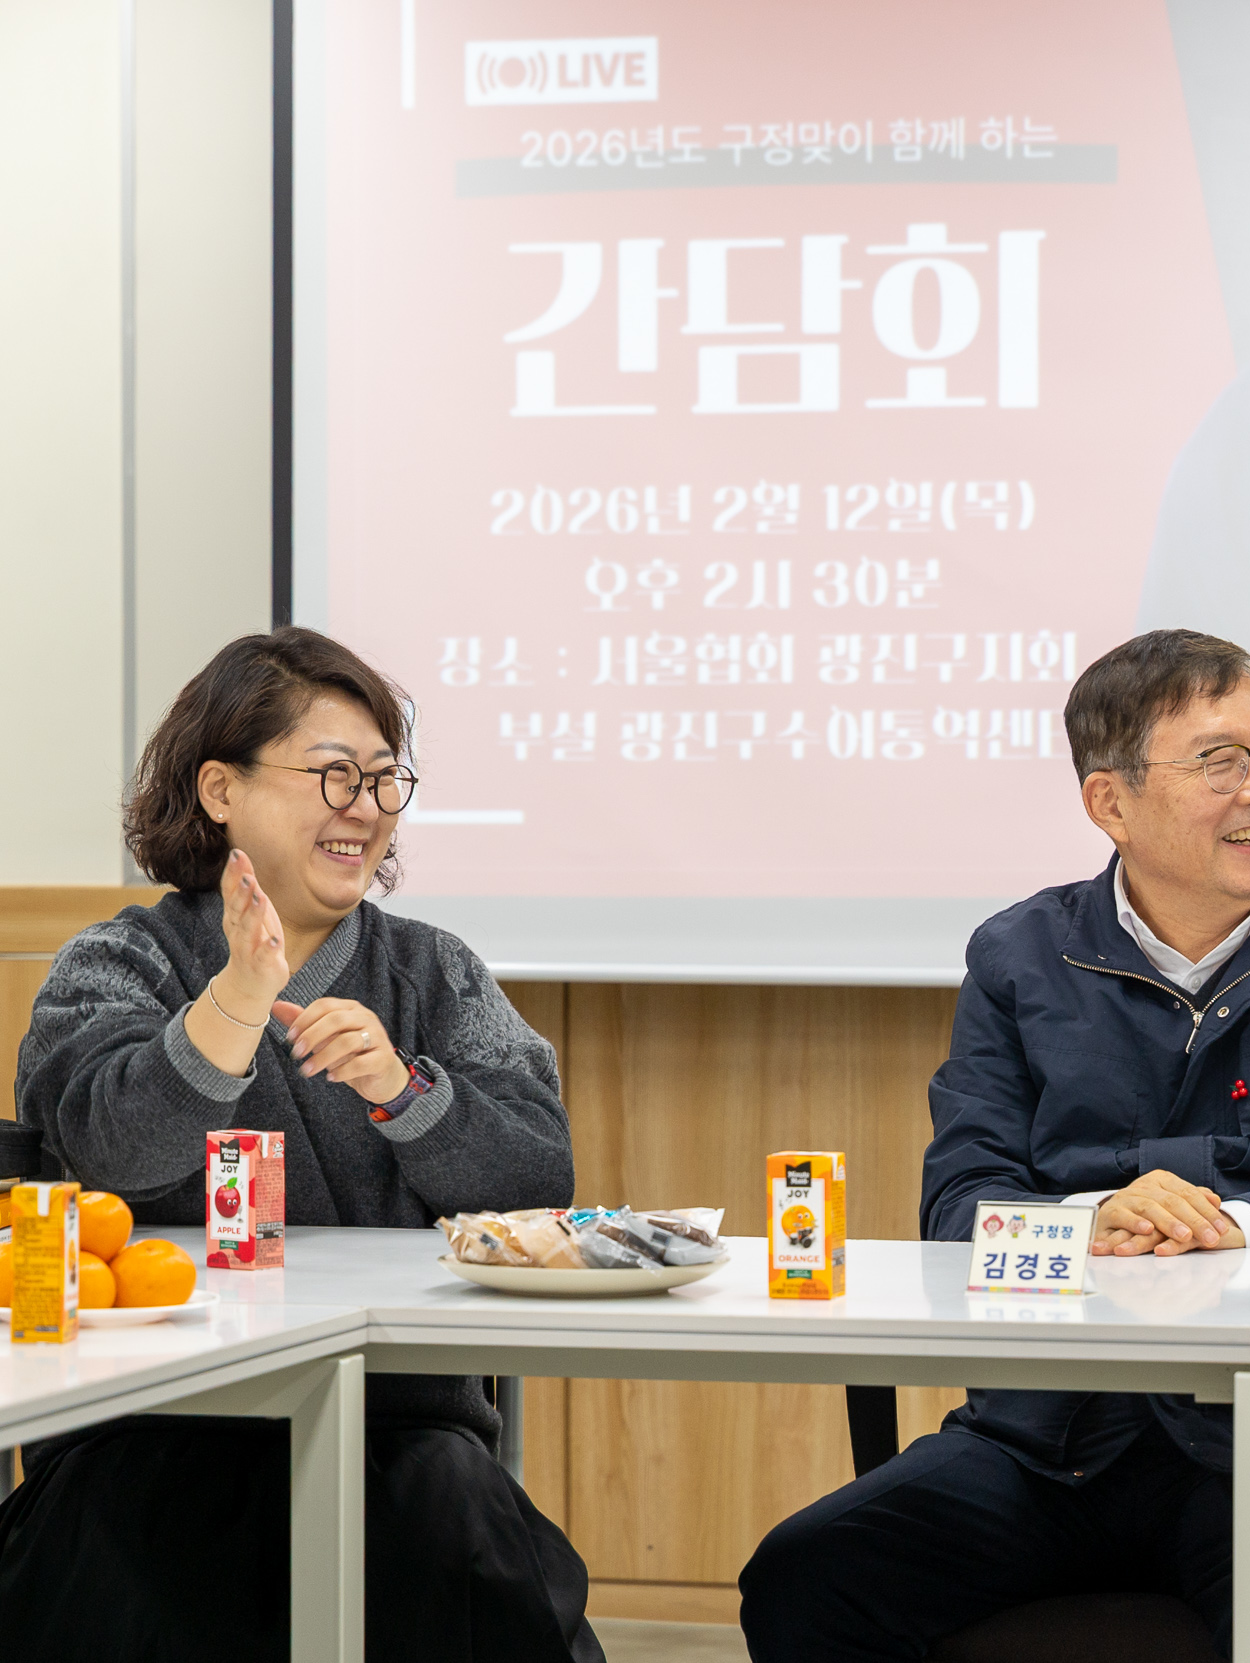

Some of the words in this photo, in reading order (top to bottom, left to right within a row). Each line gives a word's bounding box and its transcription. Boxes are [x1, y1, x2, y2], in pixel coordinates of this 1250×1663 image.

[557, 52, 648, 90] LIVE
[520, 125, 707, 170] 2026년도
[719, 119, 874, 167] 구정맞이
[887, 116, 967, 164] 함께
[980, 114, 1059, 160] 하는
[503, 222, 1047, 418] 간담회
[490, 483, 693, 536] 2026년
[711, 479, 801, 534] 2월
[822, 476, 1037, 532] 12일(목)
[584, 556, 683, 612] 오후
[702, 559, 792, 611] 2시
[811, 555, 942, 610] 30분
[437, 635, 536, 688] 장소
[592, 629, 796, 687] 서울협회
[817, 629, 1079, 684] 광진구지회
[498, 708, 598, 762] 부설
[221, 1164, 238, 1173] JOY
[787, 1189, 810, 1198] JOY
[217, 1226, 240, 1235] APPLE
[1032, 1225, 1074, 1239] 구청장
[778, 1255, 820, 1263] ORANGE
[983, 1252, 1072, 1281] 김경호
